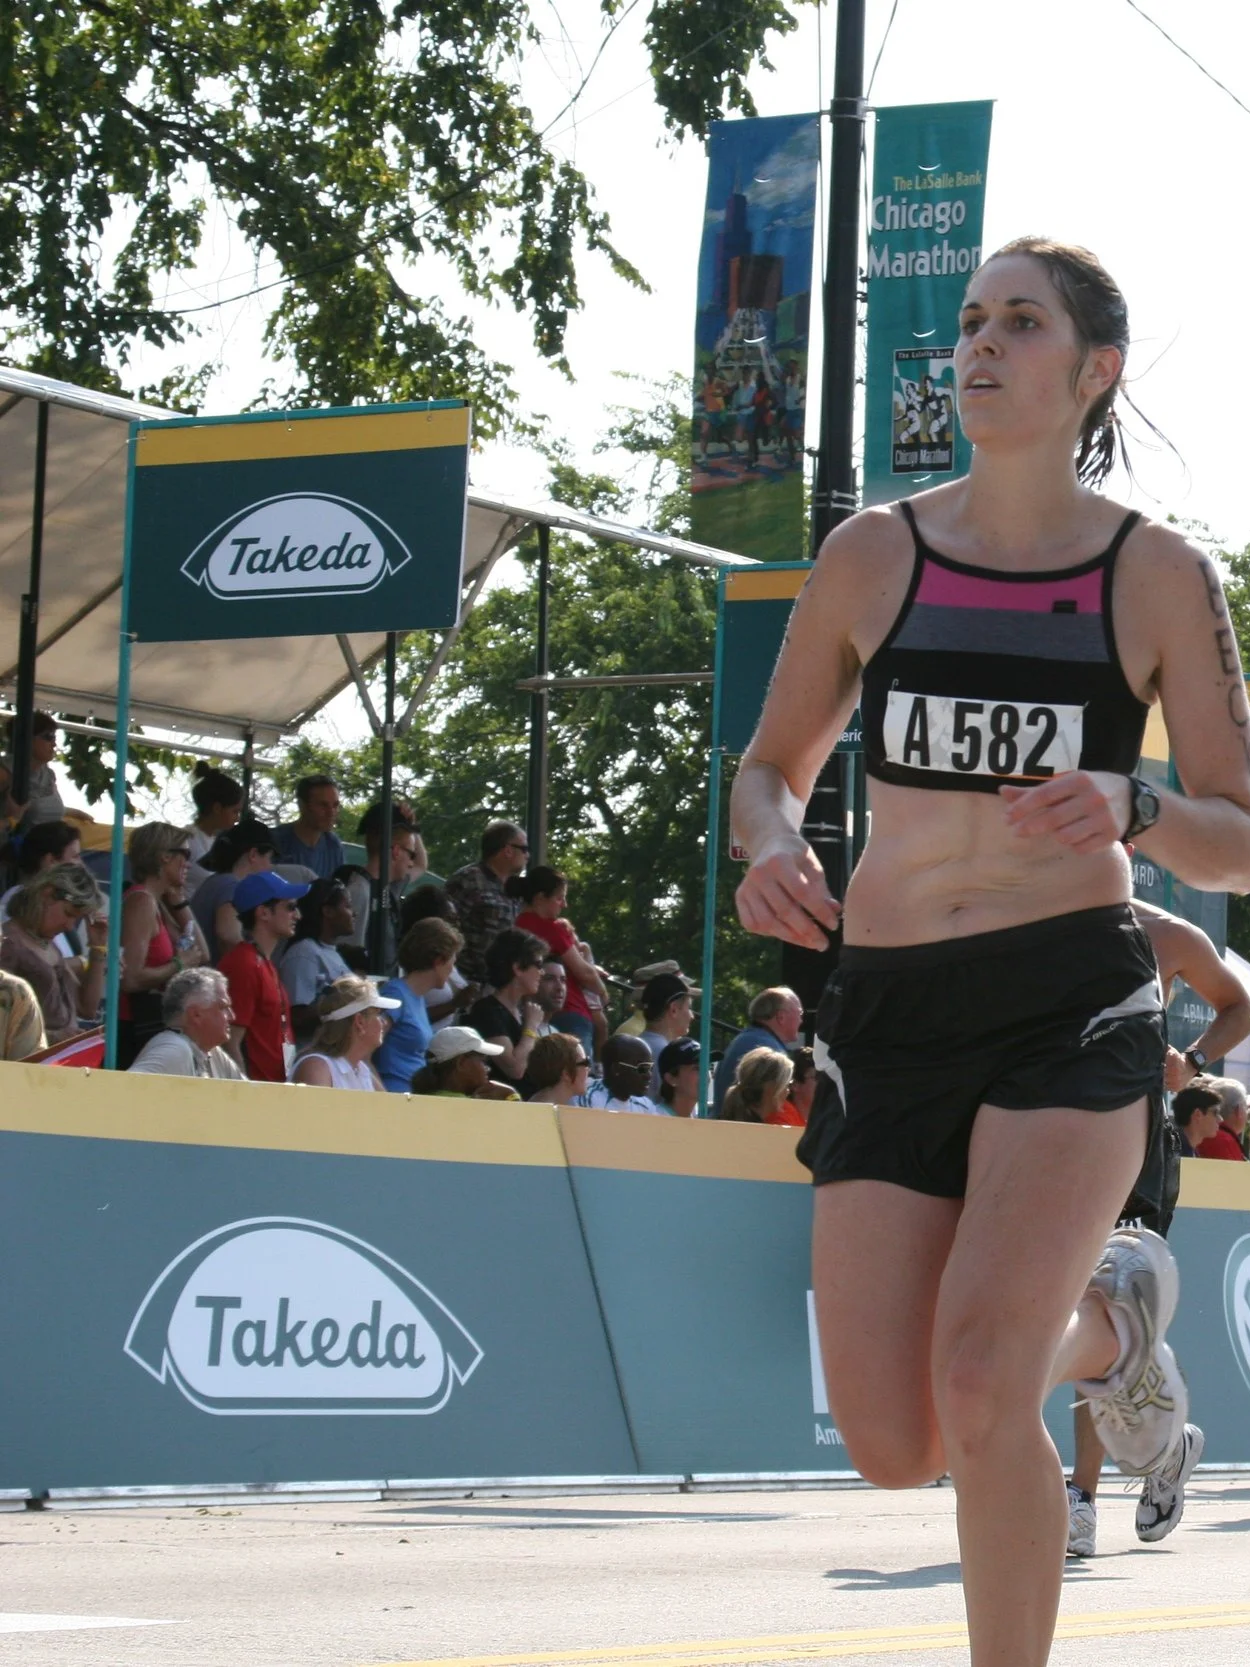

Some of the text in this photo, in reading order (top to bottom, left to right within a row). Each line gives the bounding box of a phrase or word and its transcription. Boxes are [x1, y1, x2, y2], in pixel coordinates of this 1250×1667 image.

[893, 170, 982, 191] The LaSalle Bank
[872, 195, 966, 234] Chicago
[868, 239, 982, 279] Marathon
[228, 532, 371, 576] Takeda
[903, 696, 1058, 778] A 582
[195, 1295, 426, 1368] Takeda
